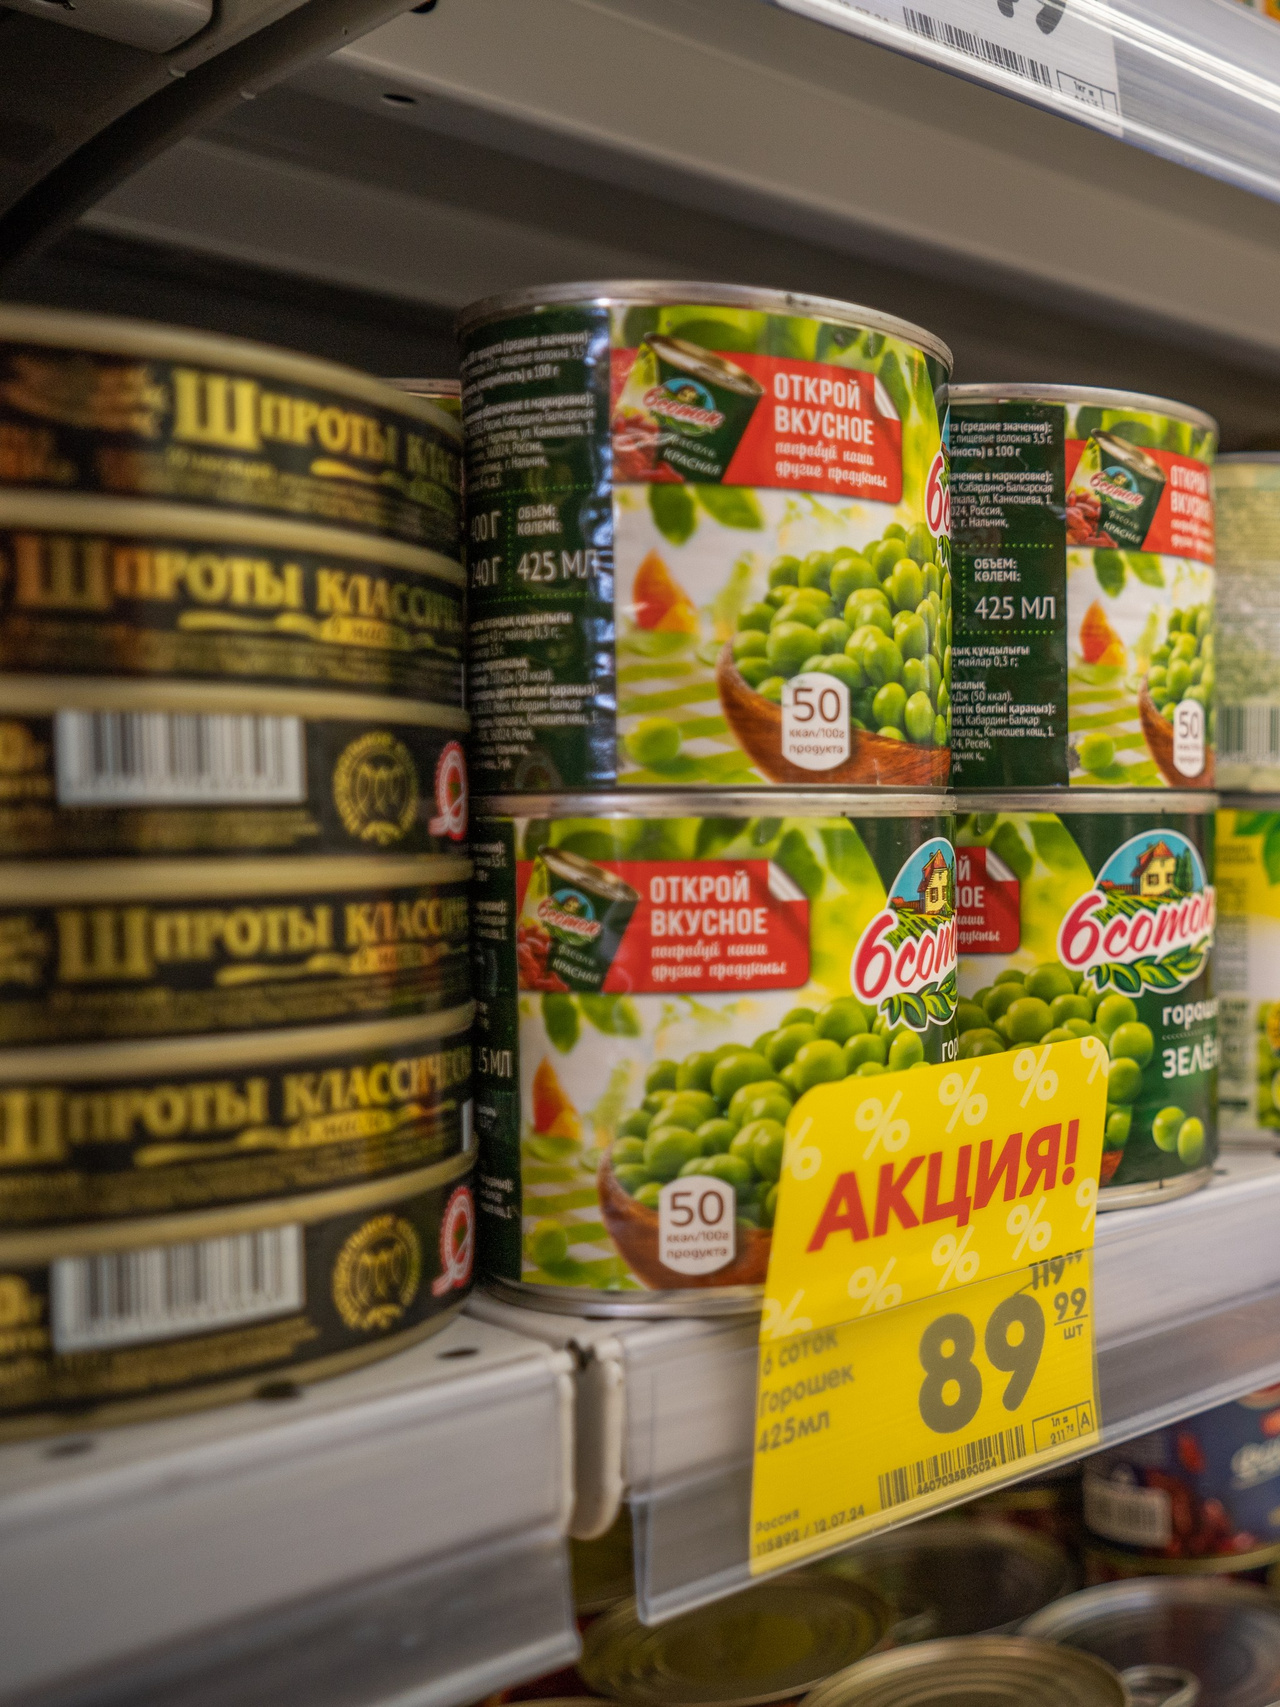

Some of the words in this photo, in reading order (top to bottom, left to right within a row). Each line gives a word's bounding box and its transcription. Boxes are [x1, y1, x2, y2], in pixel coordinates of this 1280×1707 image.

[773, 371, 860, 411] ОТКРОЙ
[773, 405, 875, 446] ВКУСНОЕ
[960, 421, 1002, 434] (средние
[1002, 421, 1054, 434] значения):
[775, 439, 837, 463] попробуй
[842, 449, 875, 466] наши
[995, 445, 1015, 457] 100
[775, 460, 823, 480] другие
[827, 464, 888, 488] продукты
[958, 481, 1054, 494] Кабардино-Балкарская
[992, 470, 1054, 483] маркировке):
[992, 493, 1044, 506] Канкошева,
[968, 517, 1010, 529] Нальчик,
[516, 550, 558, 582] 425
[560, 549, 598, 580] МЛ
[974, 558, 1018, 571] ОБЪЕМ:
[974, 596, 1015, 620] 425
[1021, 596, 1056, 620] МЛ
[792, 687, 841, 723] 50
[1178, 710, 1200, 739] 50
[789, 744, 844, 755] продукта
[650, 870, 750, 903] ОТКРОЙ
[650, 907, 768, 936] ВКУСНОЕ
[650, 939, 721, 960] попробуй
[727, 943, 768, 957] наши
[651, 962, 703, 982] другие
[708, 959, 788, 981] продукты
[805, 1118, 1080, 1254] АКЦИЯ!
[669, 1190, 725, 1227] 50
[666, 1247, 729, 1260] продукта
[778, 1328, 839, 1369] соток
[918, 1293, 1046, 1434] 89
[1053, 1287, 1087, 1321] 99
[759, 1362, 856, 1419] Горошек
[757, 1409, 831, 1453] 425мл
[755, 1508, 800, 1534] Россия
[813, 1503, 866, 1535] 12.07.24
